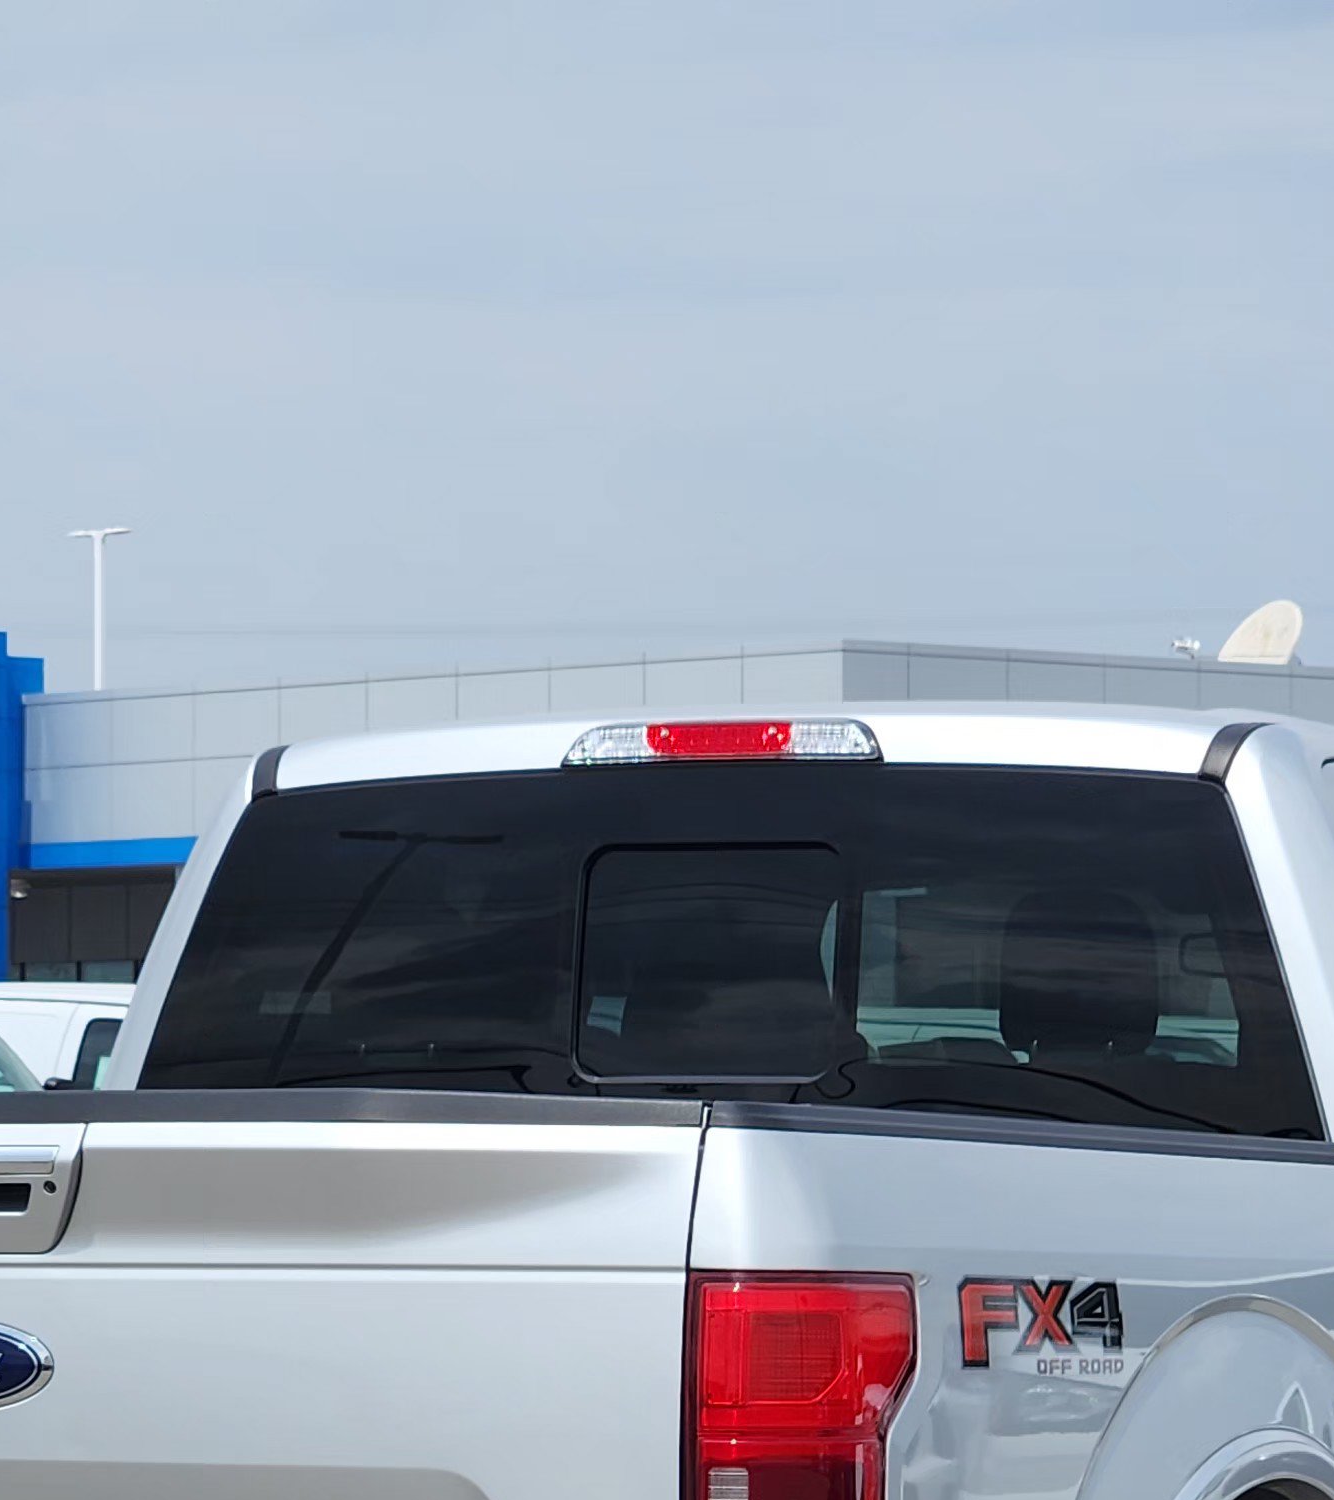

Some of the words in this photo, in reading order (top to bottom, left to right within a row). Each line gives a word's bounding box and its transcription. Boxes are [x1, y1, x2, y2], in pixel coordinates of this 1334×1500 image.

[958, 1275, 1124, 1369] FX4
[1036, 1359, 1072, 1375] OFF
[1078, 1359, 1124, 1375] ROAD
